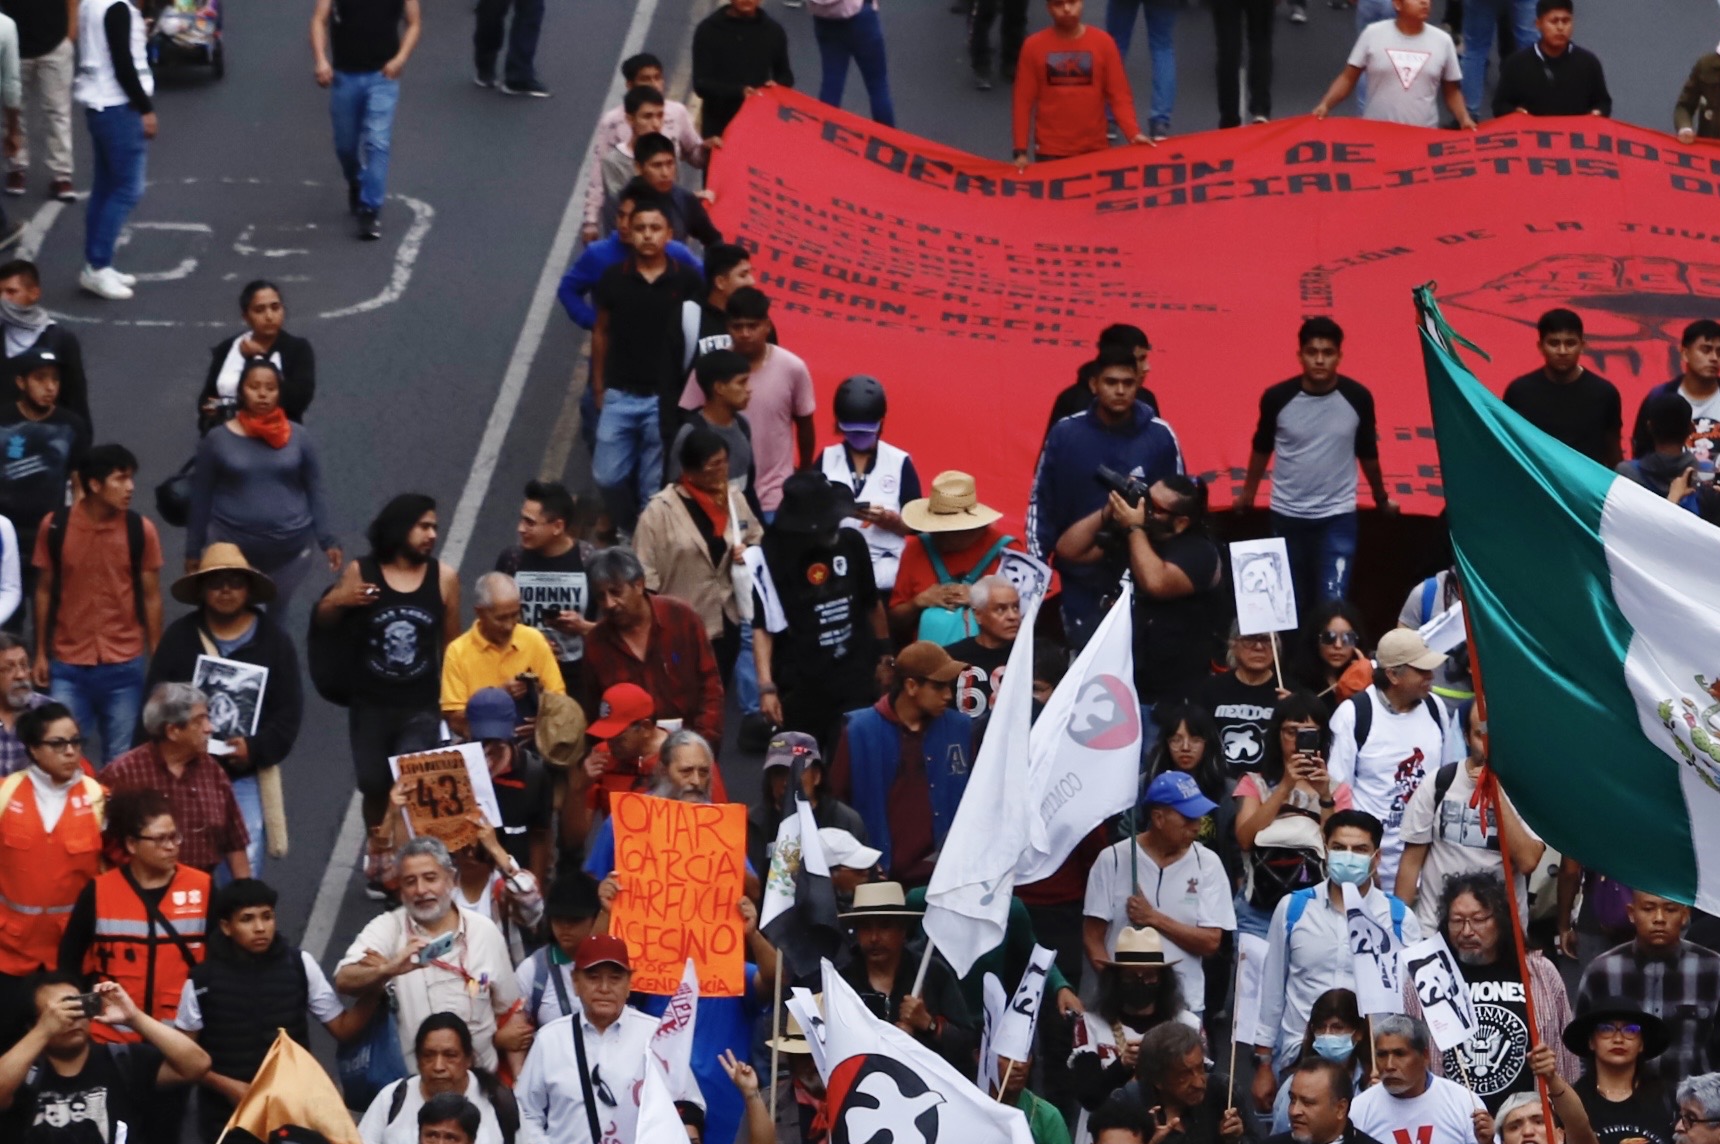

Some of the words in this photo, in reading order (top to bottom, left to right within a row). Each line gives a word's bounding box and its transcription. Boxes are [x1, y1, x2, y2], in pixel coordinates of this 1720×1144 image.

[776, 104, 1235, 201] FEDERACIÓN
[1284, 139, 1376, 165] DE
[1094, 155, 1620, 215] SOCIALISTAS
[416, 775, 465, 819] 43
[618, 792, 735, 852] OMAR
[618, 834, 739, 885] GARCÍA
[618, 880, 735, 926] HARFUCH
[613, 915, 738, 967] ASESINO
